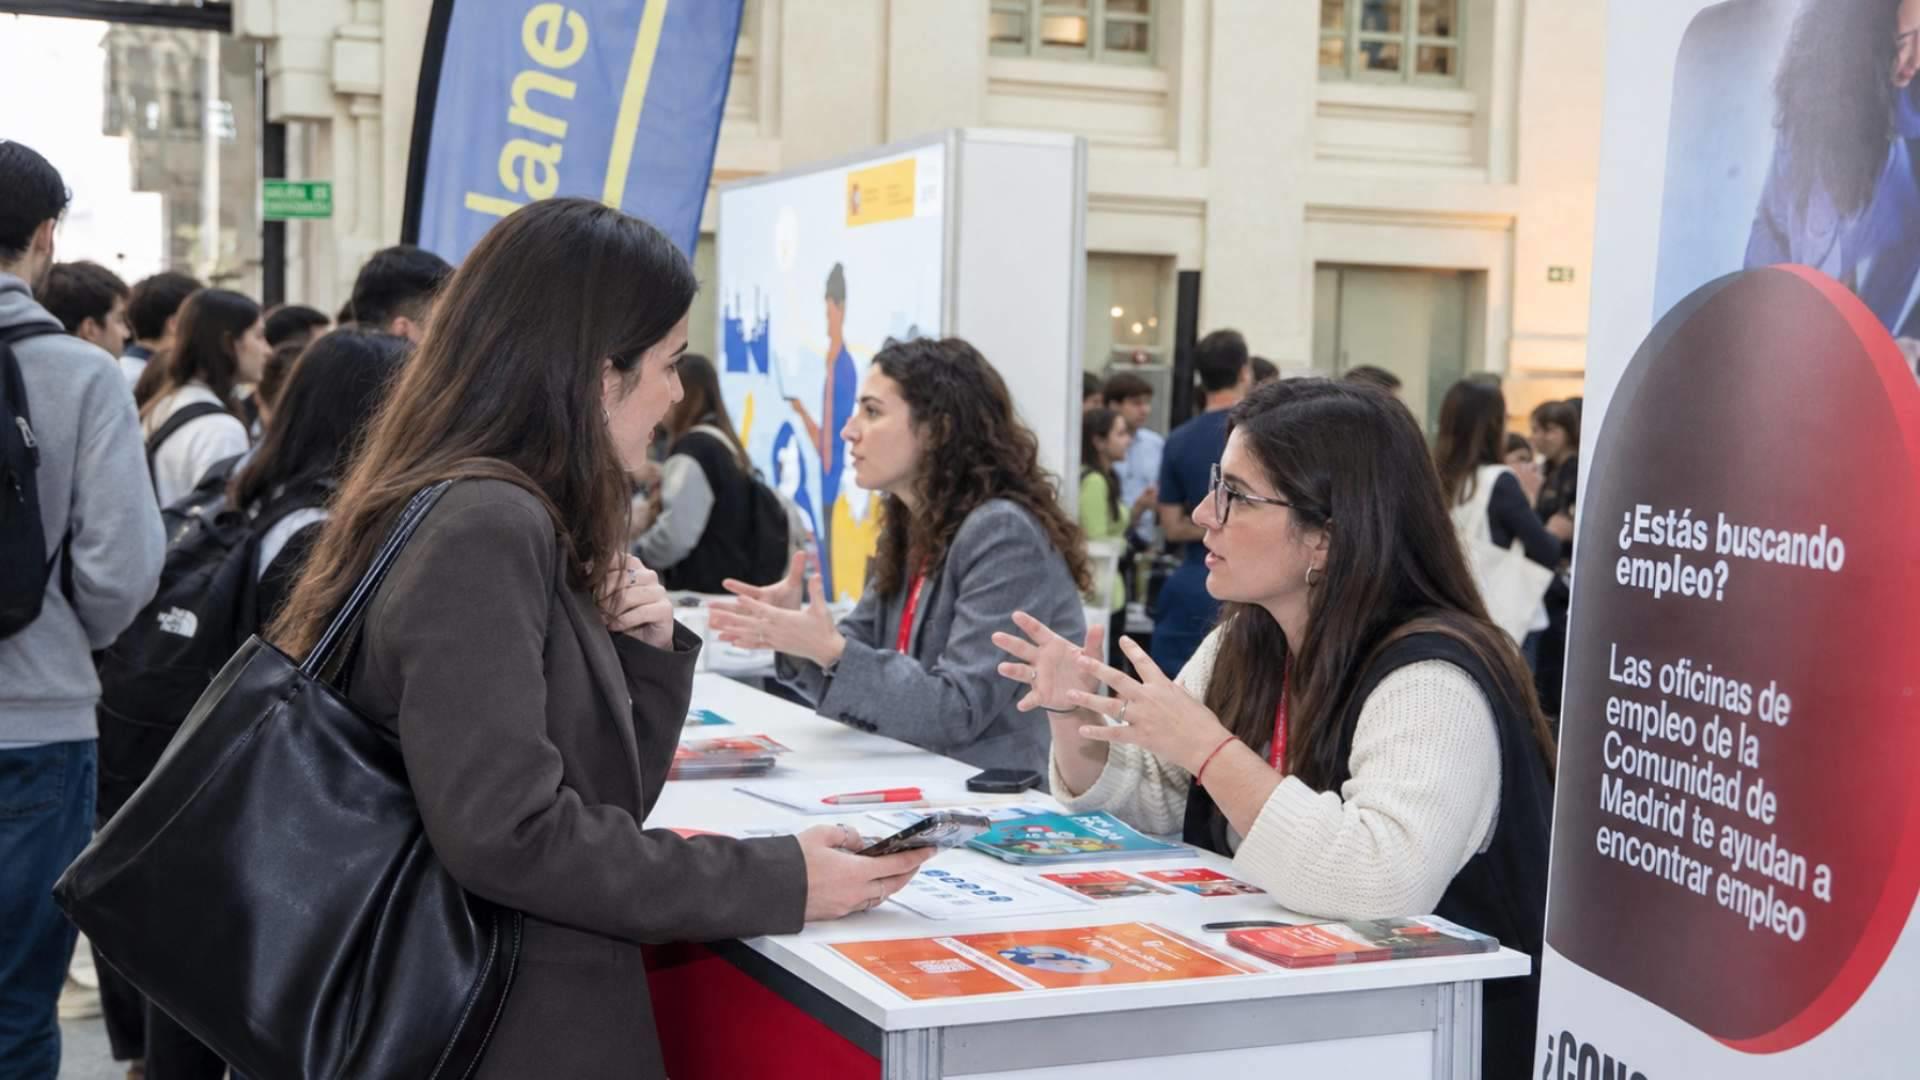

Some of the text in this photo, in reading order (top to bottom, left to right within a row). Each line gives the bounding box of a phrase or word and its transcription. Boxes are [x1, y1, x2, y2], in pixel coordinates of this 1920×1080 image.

[1615, 553, 1729, 601] empleo?
[1618, 503, 1845, 572] ¿Estás buscando
[1608, 643, 1792, 727] Las oficinas de
[1605, 695, 1759, 769] empleo de la
[1603, 730, 1777, 825] Comunidad de
[1600, 772, 1832, 903] Madrid te ayudan a
[1596, 825, 1806, 942] encontrar empleo
